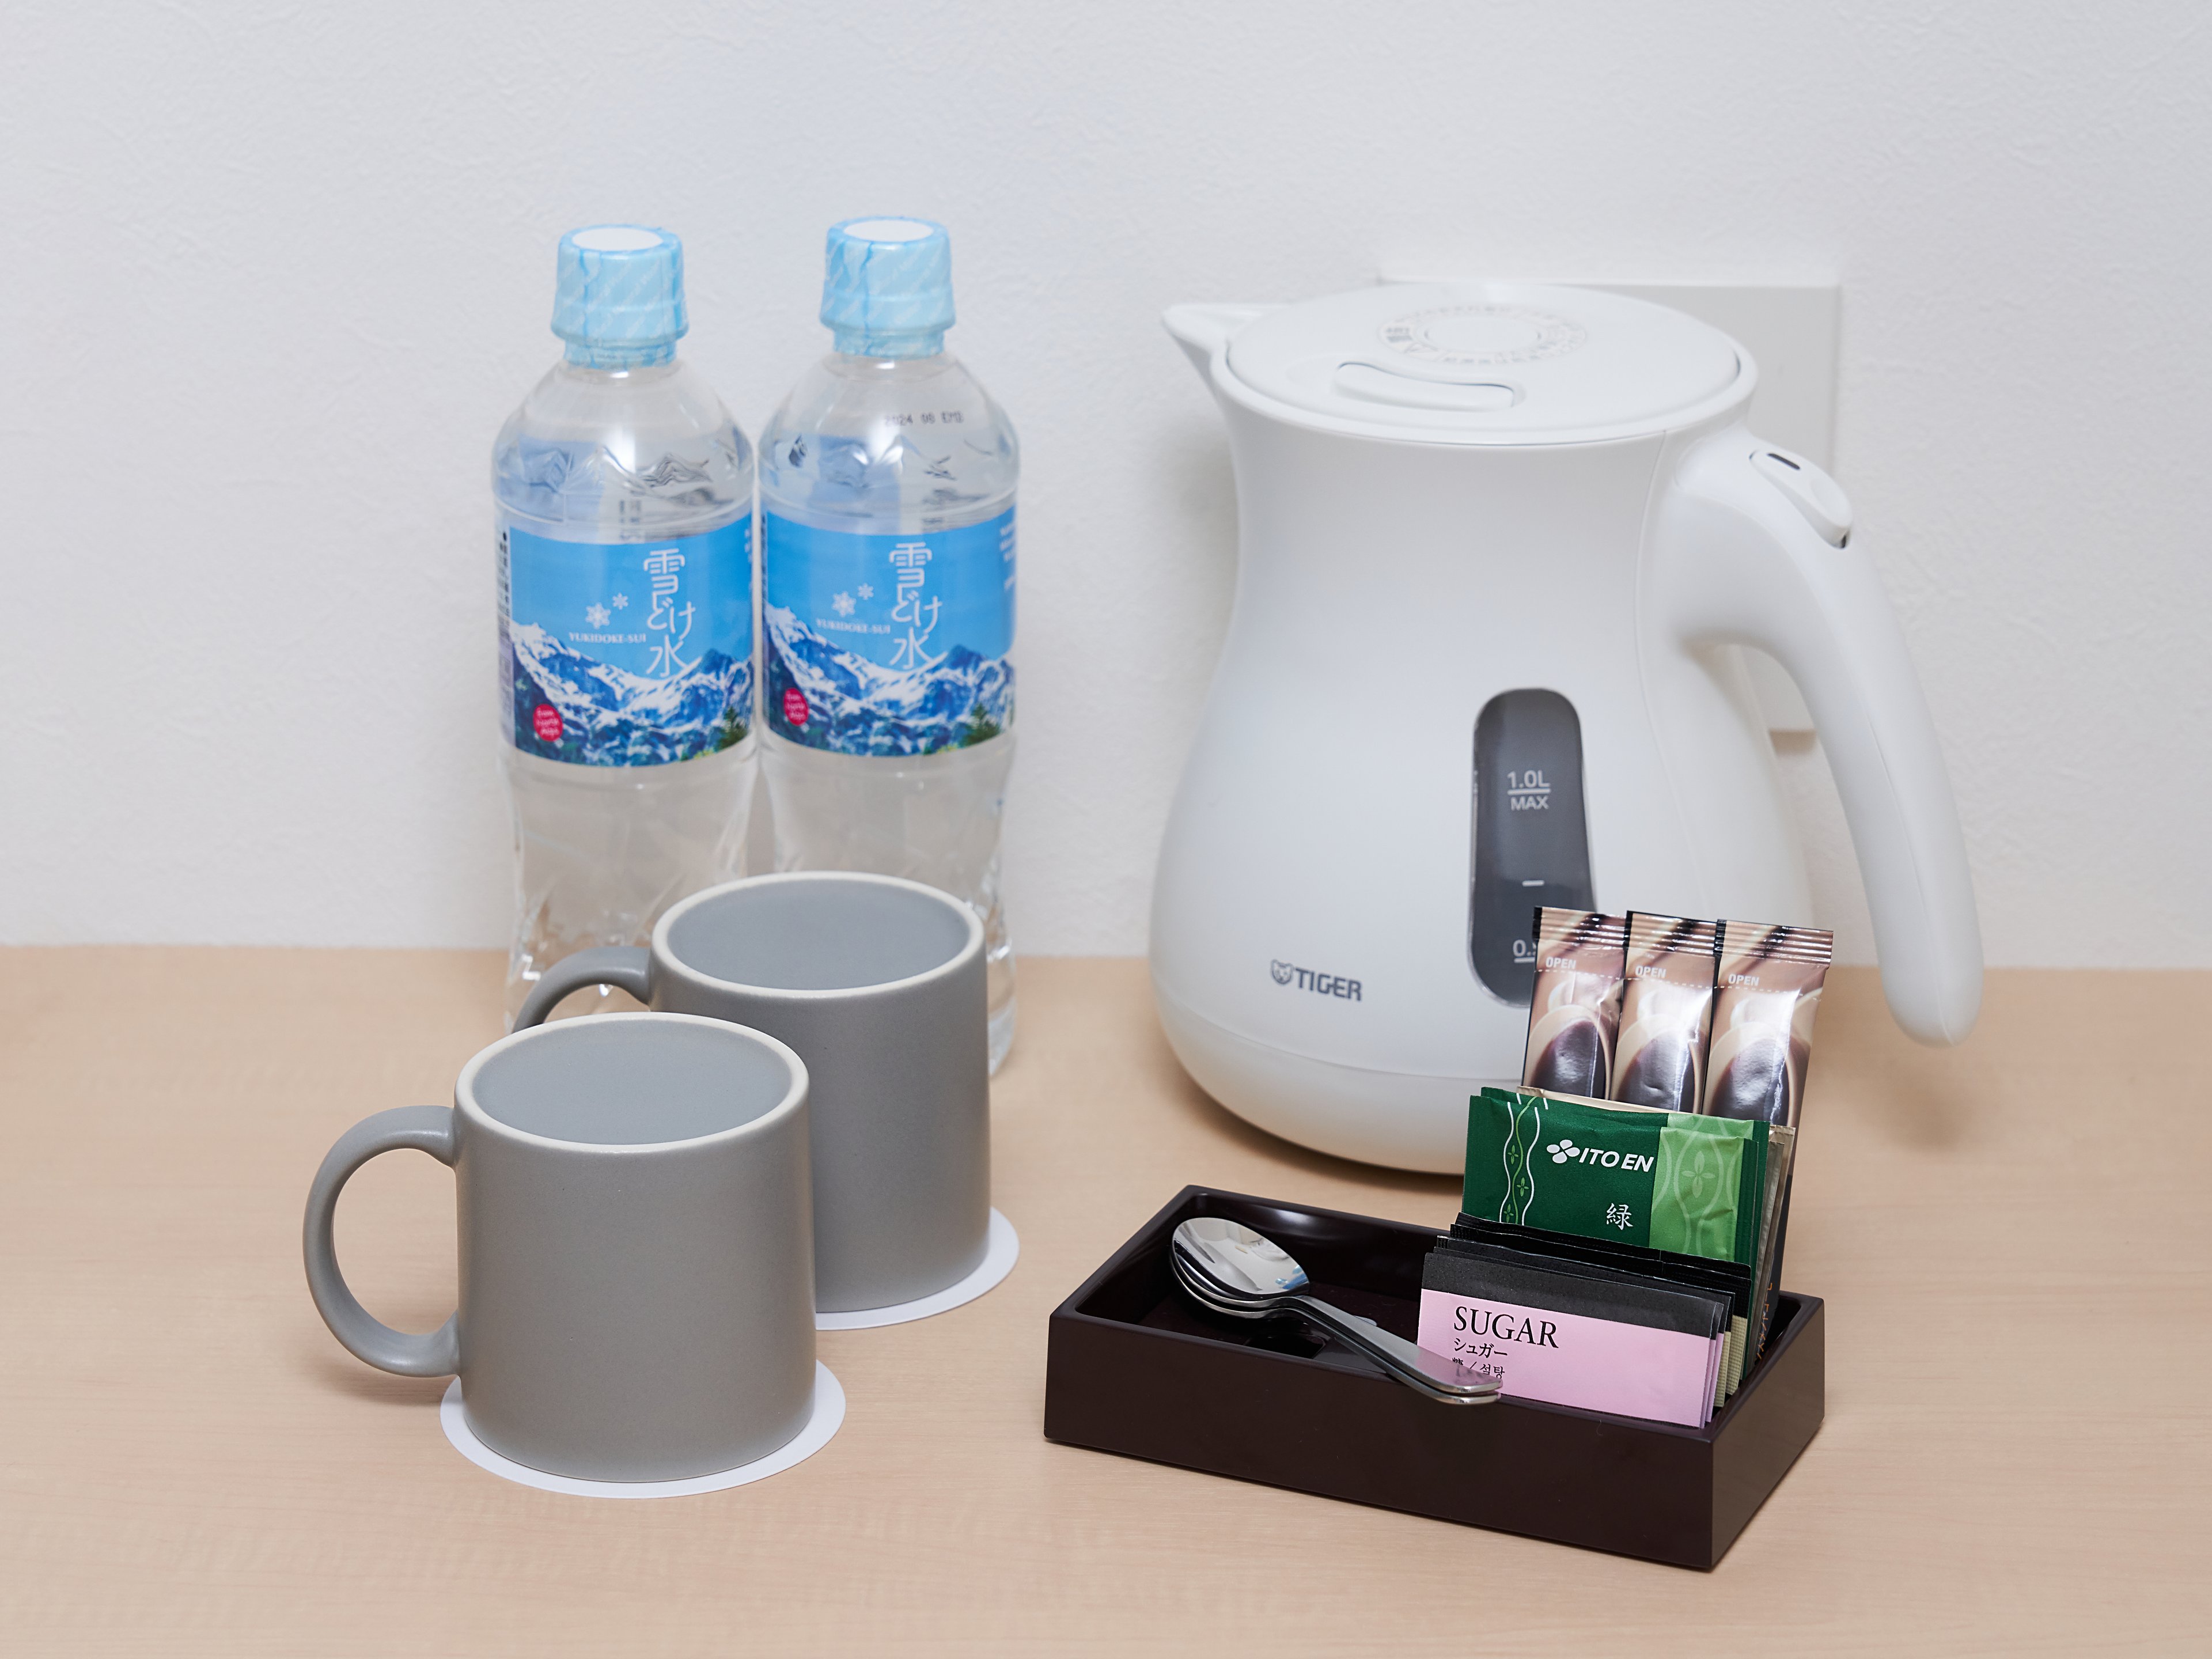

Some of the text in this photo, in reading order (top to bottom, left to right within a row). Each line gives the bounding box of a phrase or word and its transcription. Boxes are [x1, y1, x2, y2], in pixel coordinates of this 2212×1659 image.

[643, 548, 701, 677] 雪どけ水
[889, 541, 948, 669] 雪どけ水
[1507, 770, 1550, 789] 1.0L
[1510, 796, 1549, 810] MAX
[1546, 956, 1577, 971] OPEN
[1635, 965, 1666, 979] OPEN
[1296, 967, 1362, 1001] TIGER
[1729, 974, 1760, 987] OPEN
[1579, 1147, 1655, 1172] ITO EN
[1606, 1203, 1634, 1230] 緑
[1453, 1305, 1559, 1349] SUGAR
[1454, 1337, 1508, 1358] シュガー
